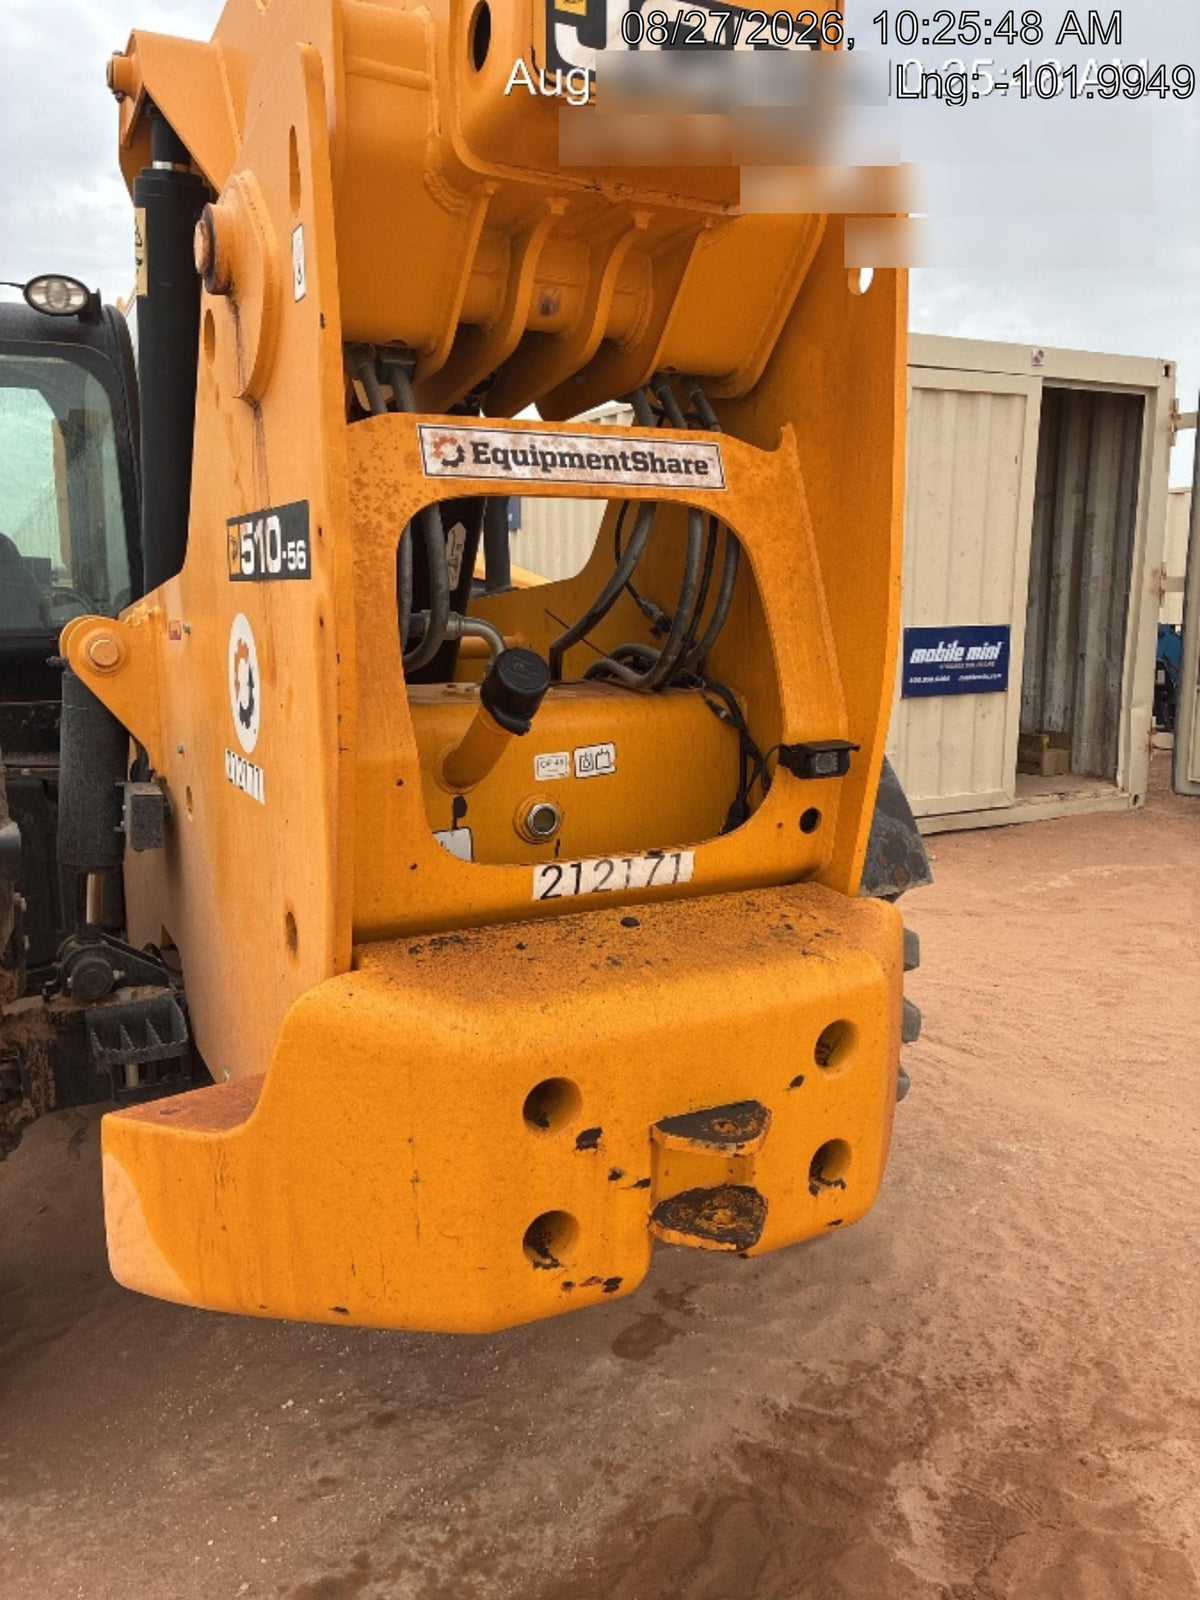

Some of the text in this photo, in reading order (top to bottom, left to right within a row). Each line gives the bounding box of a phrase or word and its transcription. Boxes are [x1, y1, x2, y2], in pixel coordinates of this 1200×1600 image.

[470, 441, 710, 476] EquipmentShare
[909, 639, 1003, 664] mobile mini
[539, 852, 683, 900] 212171
